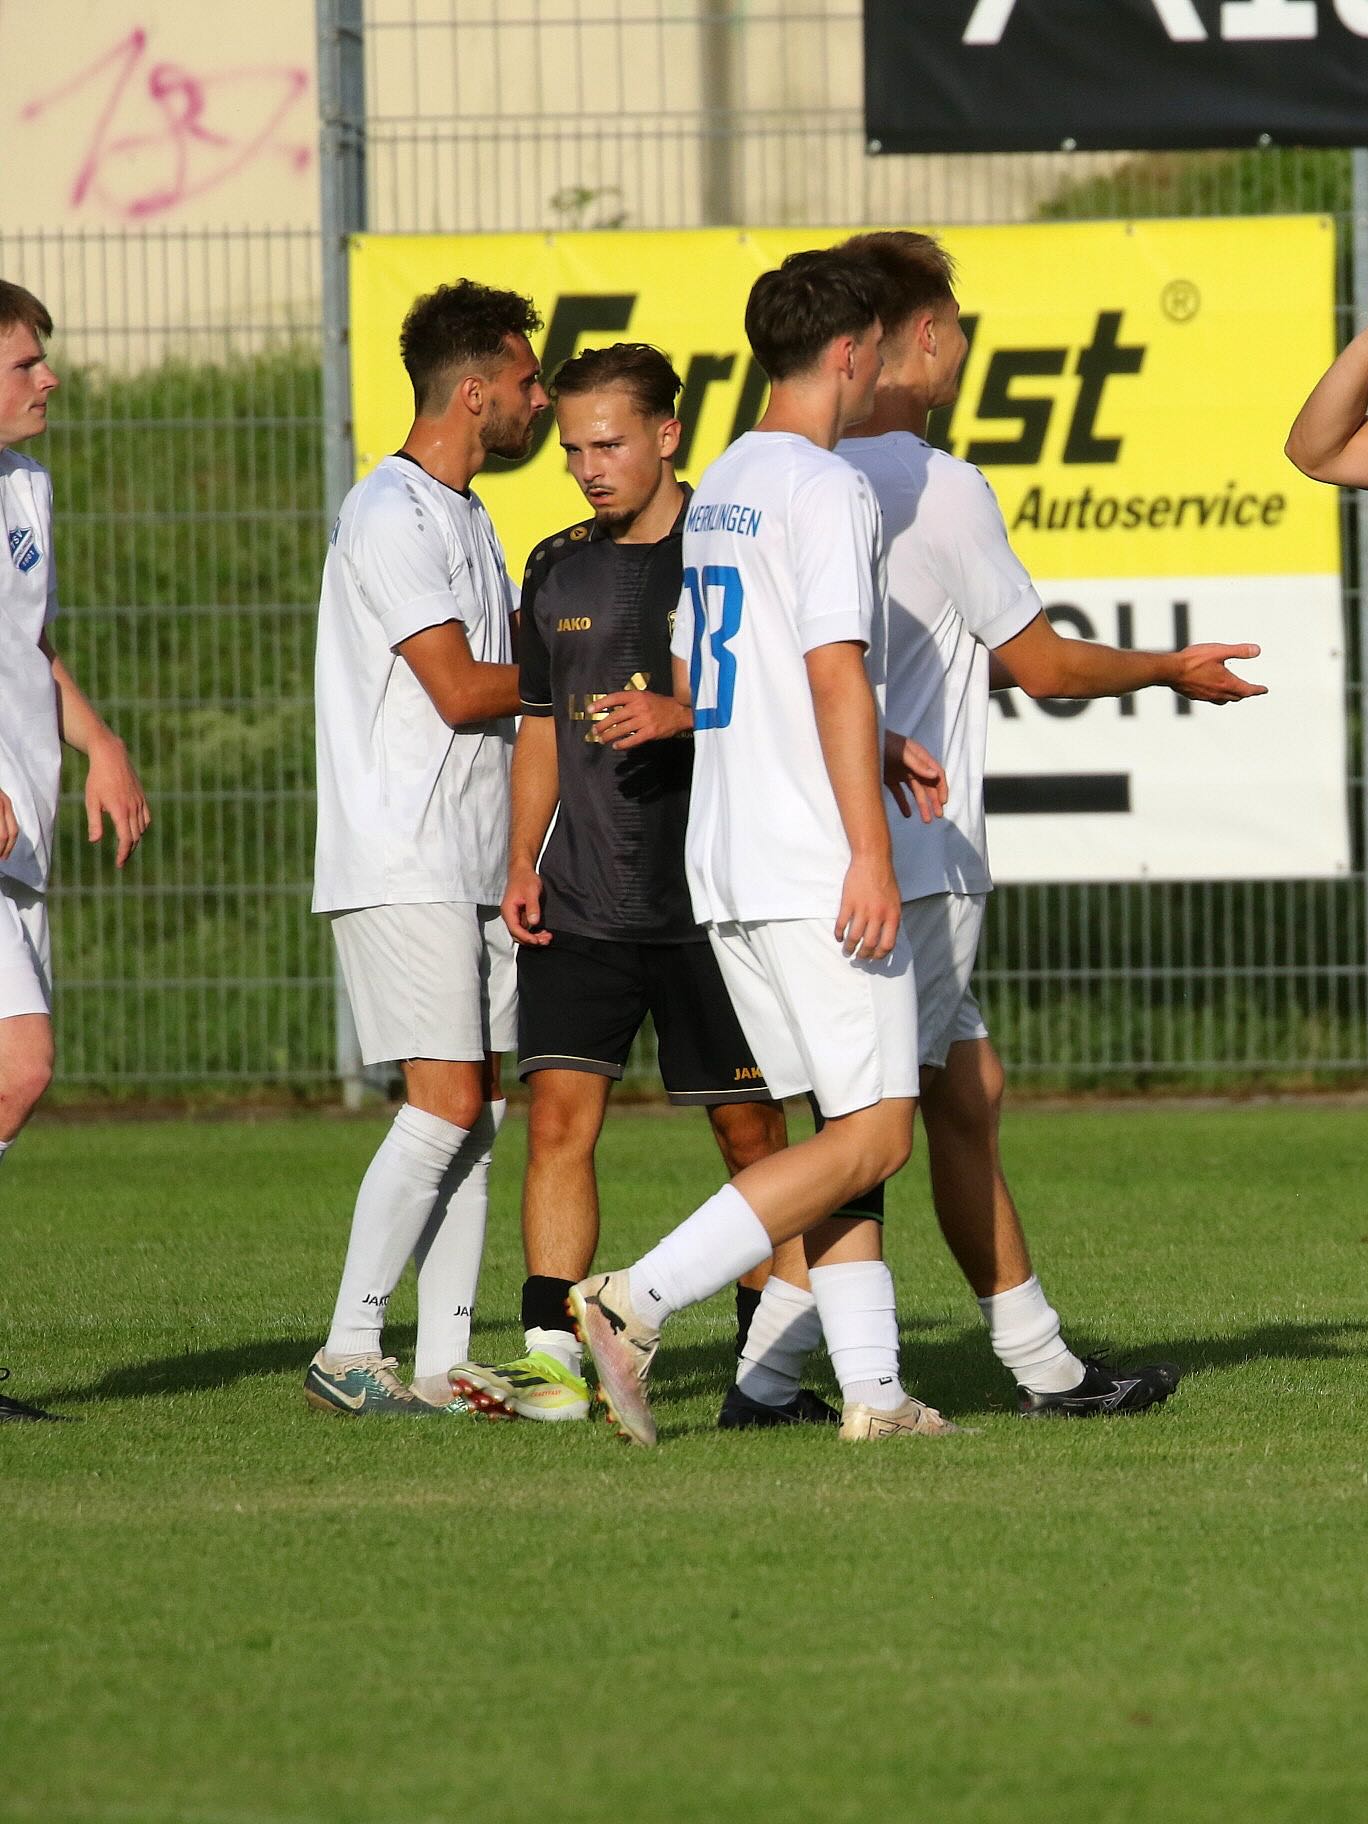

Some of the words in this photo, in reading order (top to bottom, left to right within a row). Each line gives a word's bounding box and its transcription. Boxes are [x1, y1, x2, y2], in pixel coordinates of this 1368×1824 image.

[1012, 480, 1287, 532] Autoservice
[556, 616, 593, 633] JAKO
[734, 1067, 764, 1081] JAK
